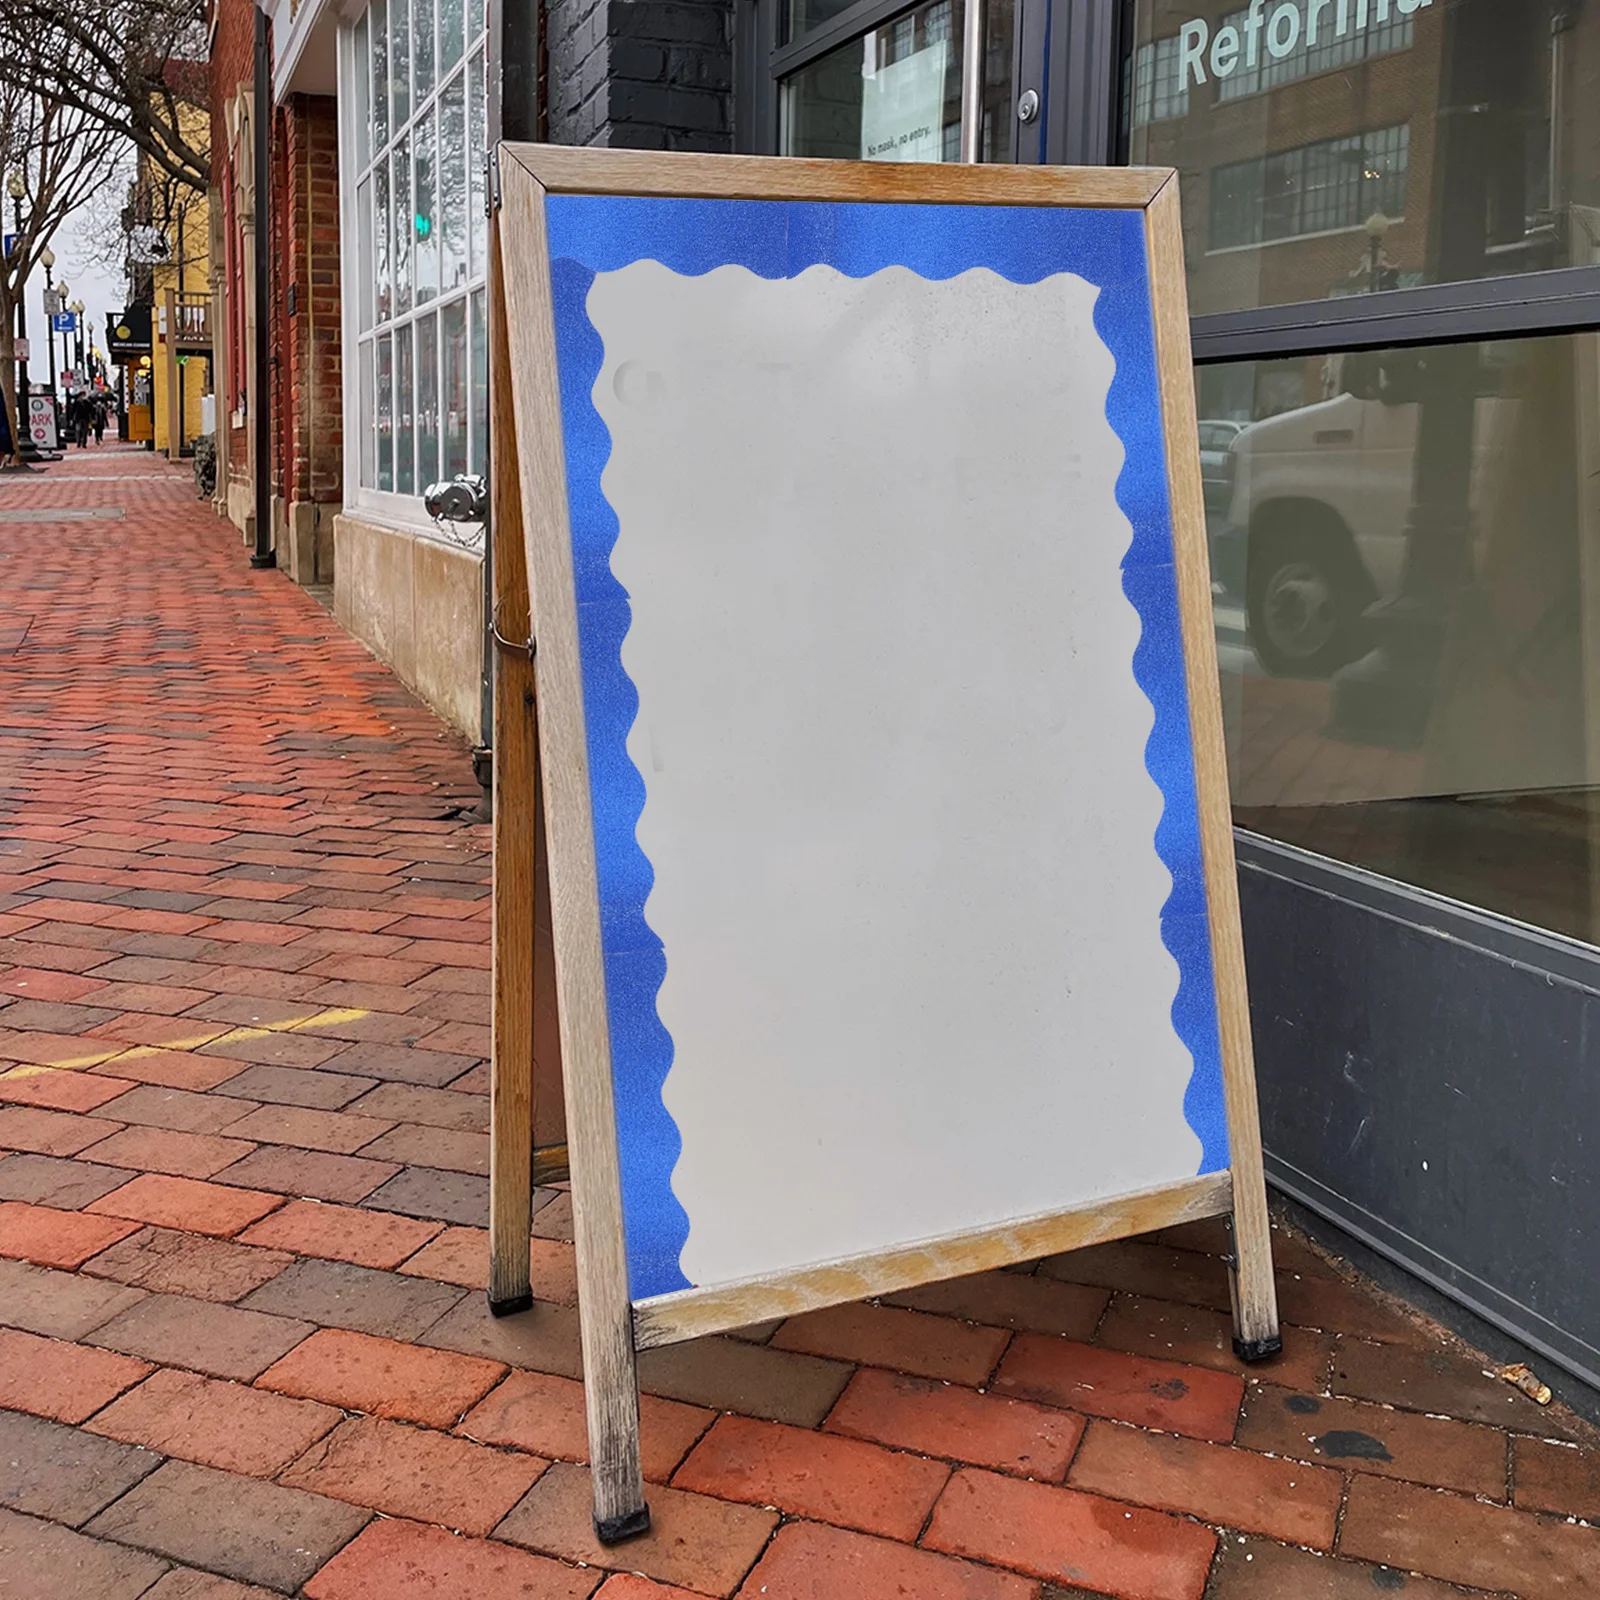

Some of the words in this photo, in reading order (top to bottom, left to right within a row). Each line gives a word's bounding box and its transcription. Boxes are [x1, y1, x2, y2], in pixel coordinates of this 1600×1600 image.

[867, 145, 876, 157] No
[877, 136, 897, 153] mask,
[899, 134, 908, 145] no
[909, 126, 931, 141] entry.
[59, 313, 69, 325] P
[29, 413, 52, 426] ARK
